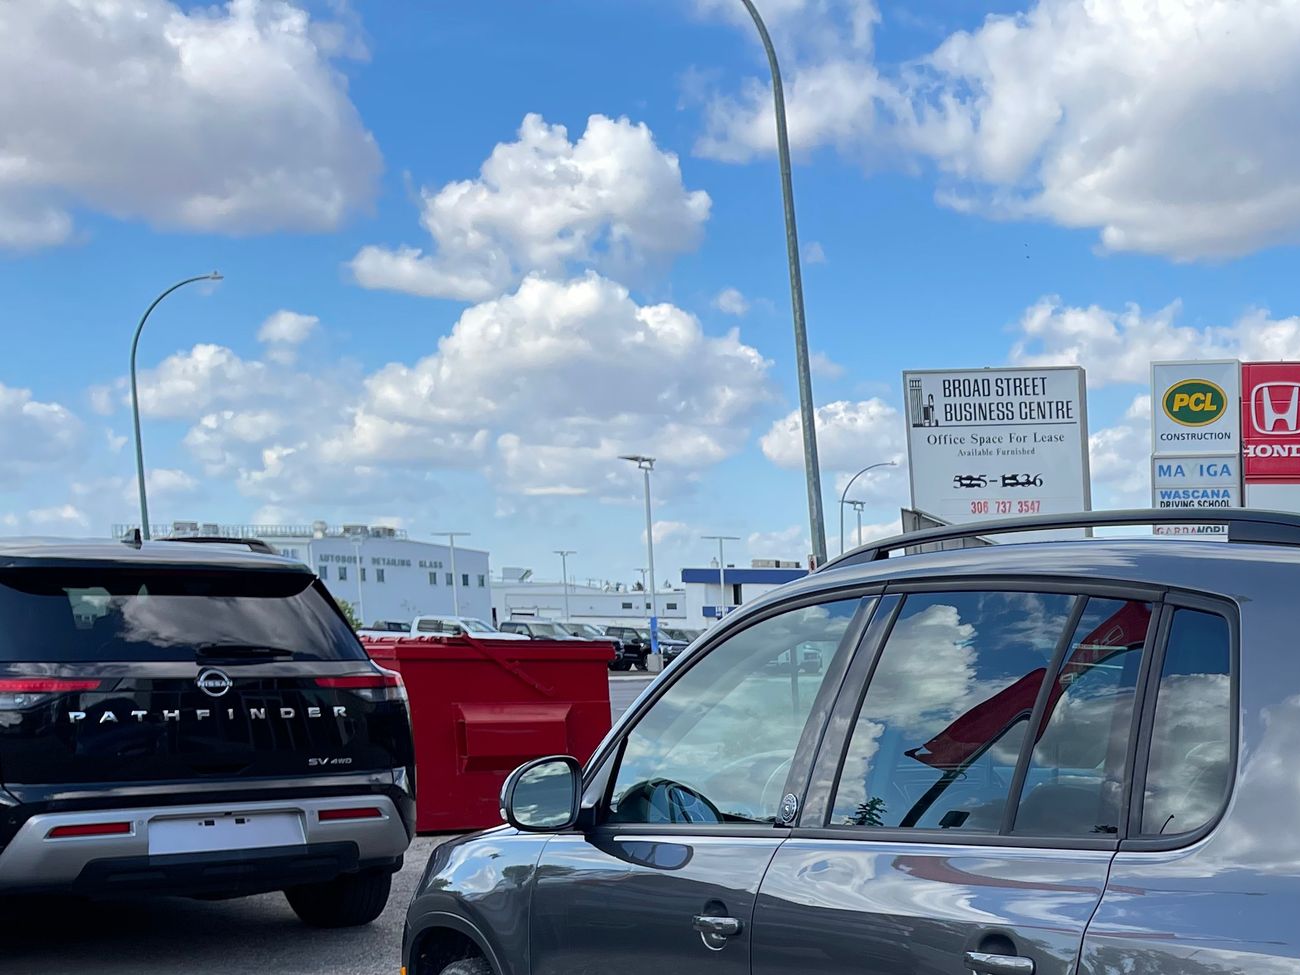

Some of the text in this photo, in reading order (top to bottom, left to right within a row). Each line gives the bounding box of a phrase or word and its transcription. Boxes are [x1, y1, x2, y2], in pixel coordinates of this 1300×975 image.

[943, 377, 1047, 398] BROAD STREET
[1172, 393, 1217, 412] PCL
[944, 400, 1074, 422] BUSINESS CENTRE
[927, 432, 1065, 447] Office Space For Lease
[1160, 432, 1231, 441] CONSTRUCTION
[957, 448, 1036, 457] Available Furnished
[1160, 489, 1231, 500] WASCANA
[970, 500, 1041, 514] 306 737 3547
[1160, 500, 1231, 508] DRIVING SCHOOL
[68, 706, 347, 724] PATHFINDER
[308, 757, 353, 766] SV 4WD
